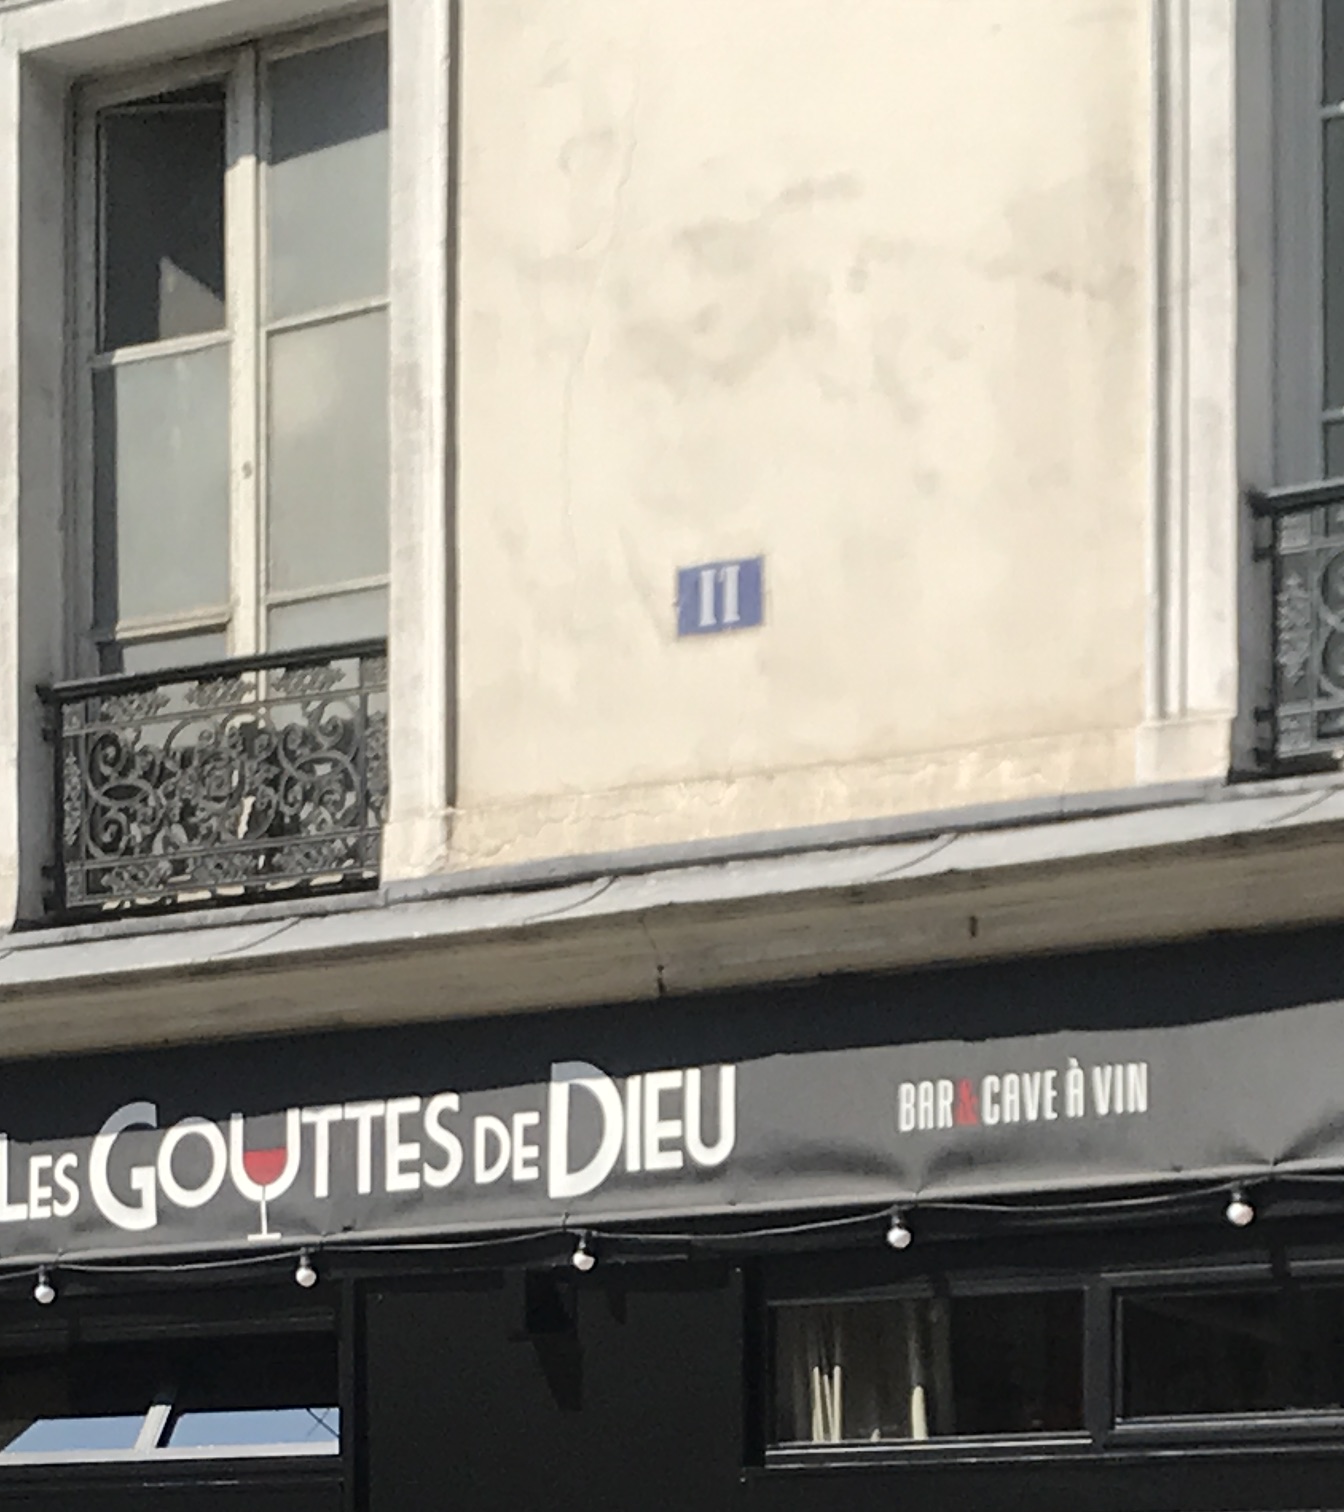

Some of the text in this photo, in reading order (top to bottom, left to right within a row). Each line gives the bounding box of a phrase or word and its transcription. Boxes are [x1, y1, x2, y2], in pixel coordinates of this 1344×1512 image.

[698, 565, 741, 627] 11
[1065, 1056, 1085, 1118] À
[1092, 1062, 1148, 1116] VIN
[88, 1091, 463, 1240] GOUTTES
[473, 1110, 540, 1184] DE
[548, 1061, 737, 1199] DIEU
